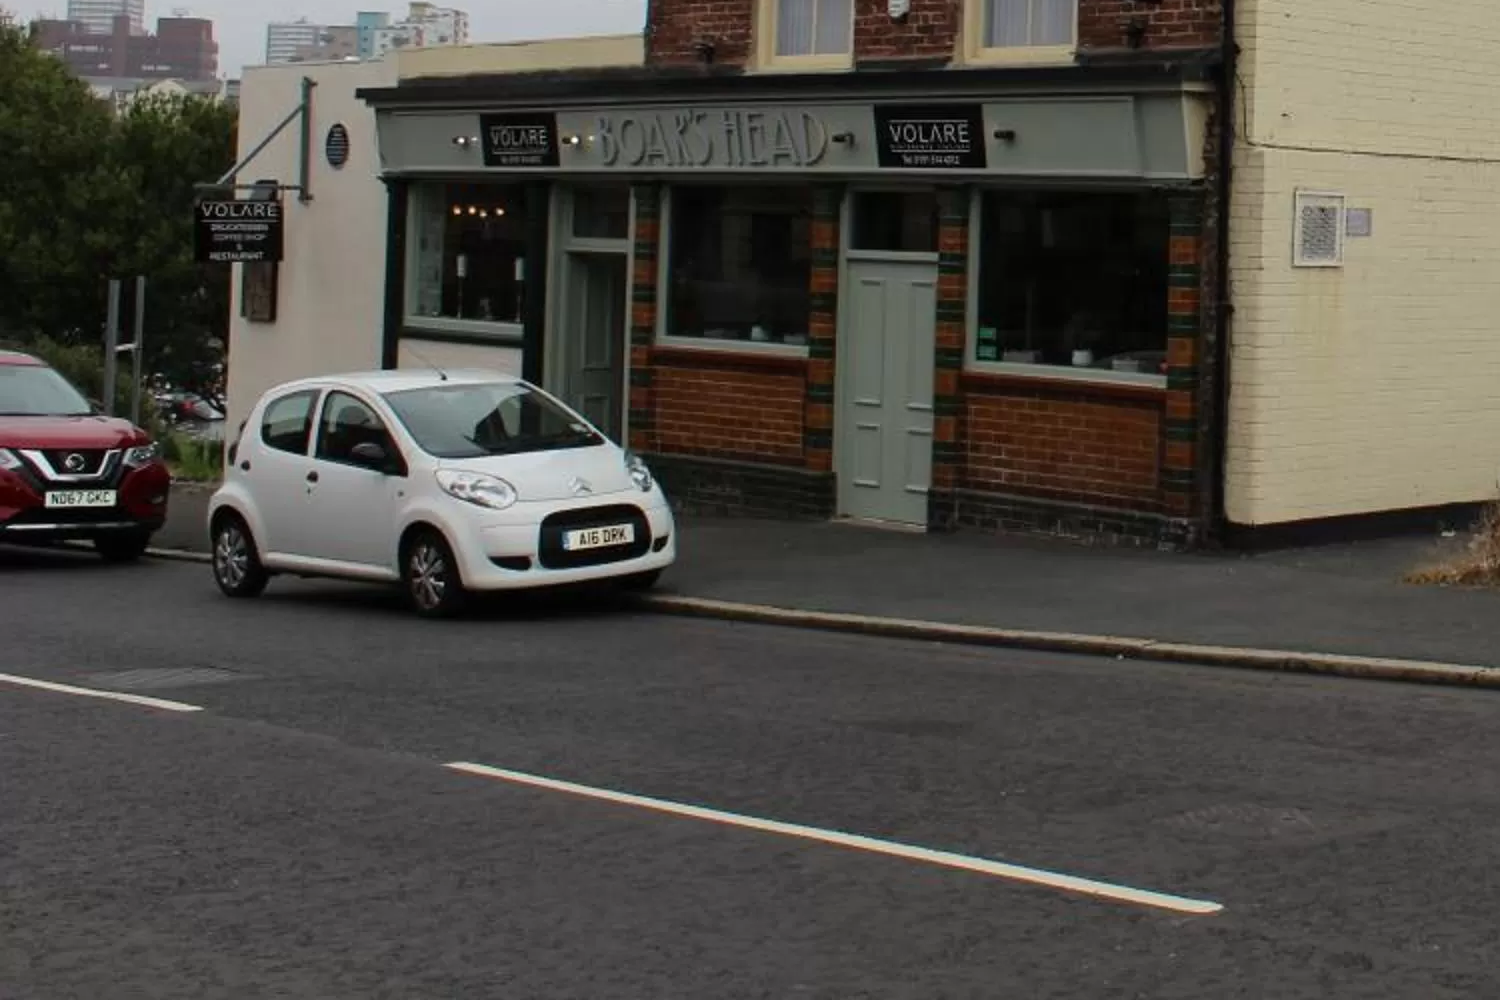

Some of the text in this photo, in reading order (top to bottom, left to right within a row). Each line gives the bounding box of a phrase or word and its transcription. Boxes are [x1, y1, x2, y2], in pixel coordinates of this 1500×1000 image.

[490, 128, 548, 148] VOLARE
[723, 110, 830, 167] HEAD
[889, 122, 971, 143] VOLARE
[202, 203, 277, 217] VOLARE
[579, 527, 627, 546] A16 DRK
